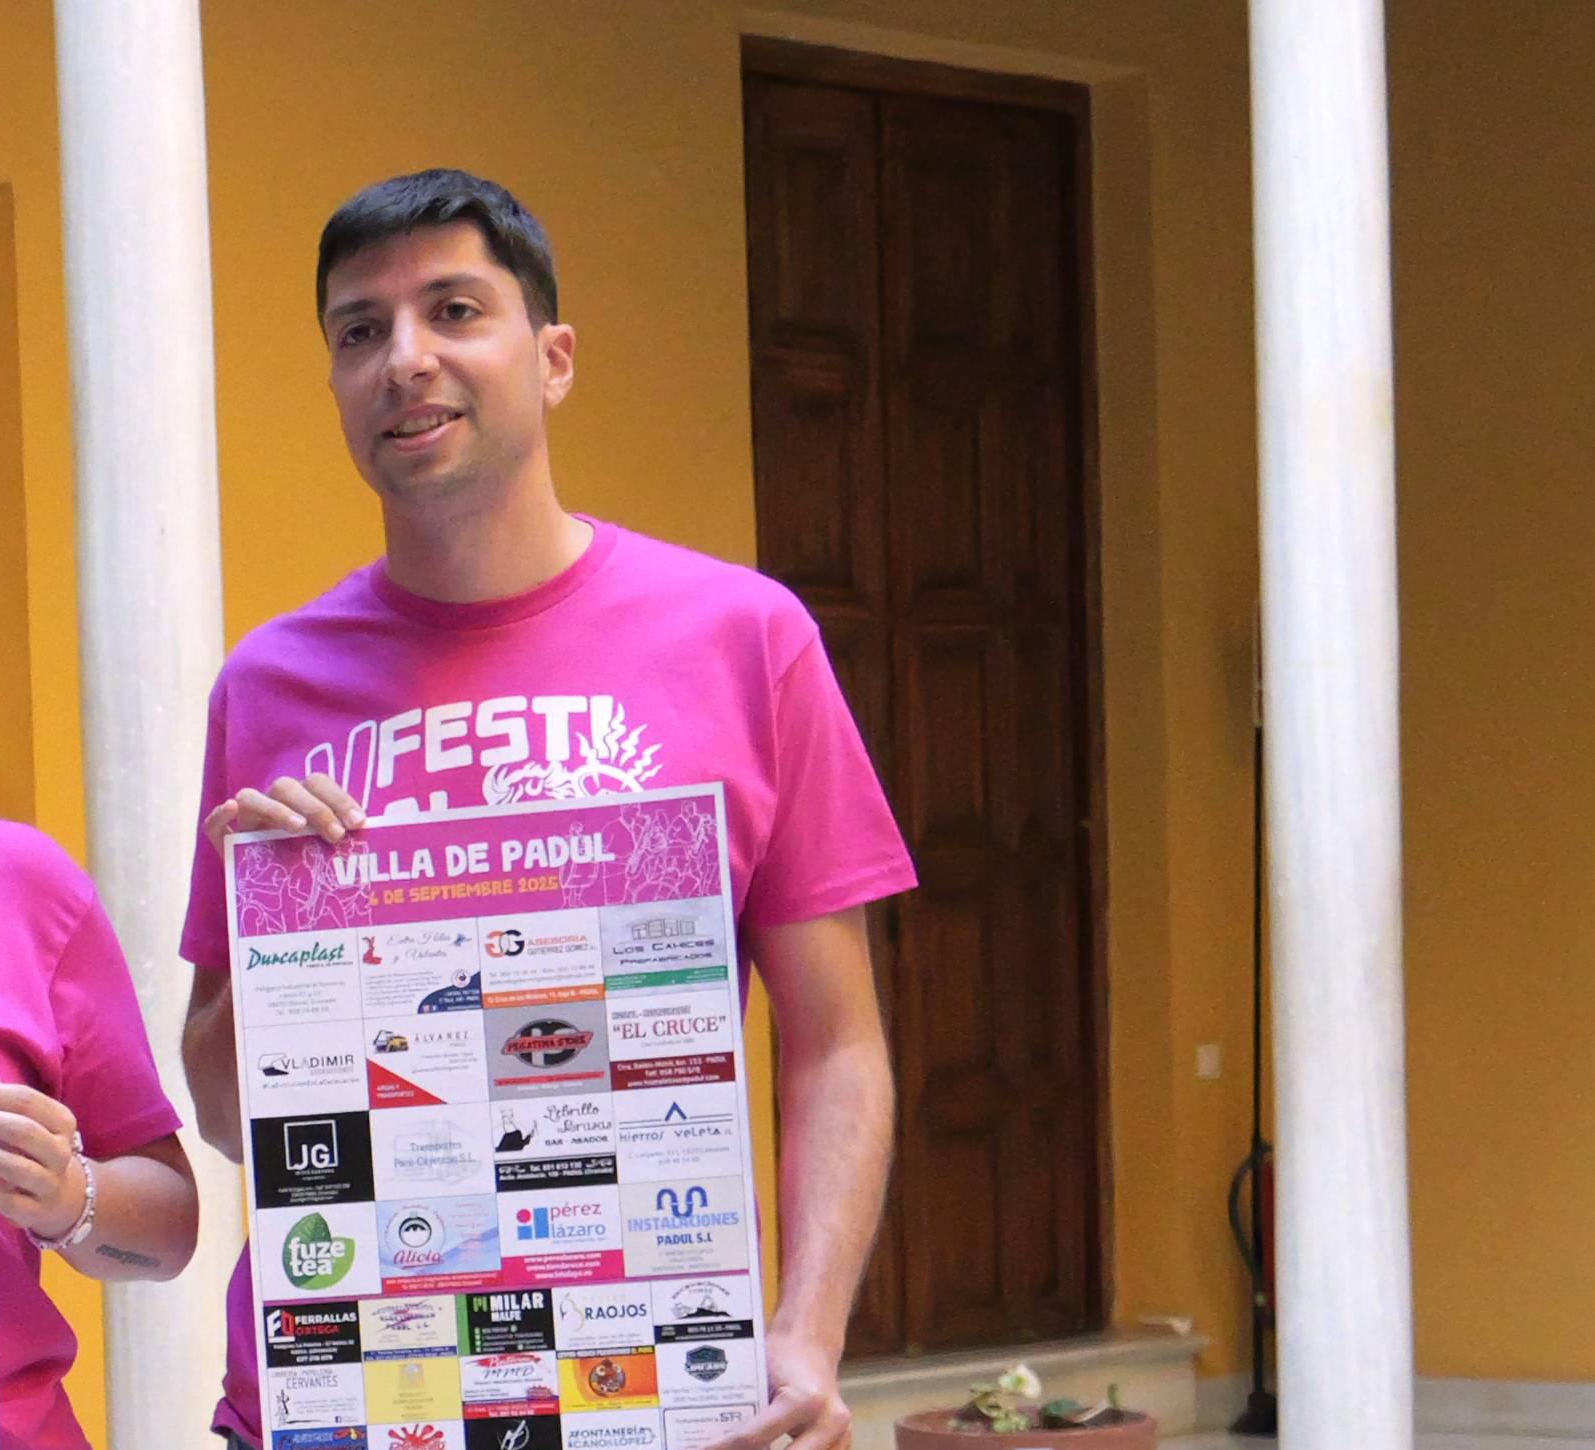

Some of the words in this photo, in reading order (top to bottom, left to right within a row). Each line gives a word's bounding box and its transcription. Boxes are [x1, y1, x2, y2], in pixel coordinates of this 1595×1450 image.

[377, 695, 613, 789] FESTI
[332, 848, 435, 887] VILLA
[445, 842, 489, 877] DE
[502, 832, 615, 872] PADUL
[384, 888, 404, 904] DE
[409, 879, 512, 903] SEPTIEMBRE
[519, 876, 558, 892] 2025
[281, 1054, 354, 1070] VLADIMIR
[293, 1143, 332, 1170] JG
[550, 1201, 602, 1221] pérez
[551, 1222, 606, 1239] lázaro
[628, 1211, 739, 1233] INSTALACIONES
[289, 1237, 345, 1259] fuze
[656, 1234, 692, 1246] PADUL
[290, 1257, 332, 1276] tea
[490, 1291, 545, 1312] MILAR
[294, 1312, 357, 1325] FERRALLAS
[295, 1325, 340, 1336] ORTEGA
[286, 1376, 338, 1389] CERVANTES
